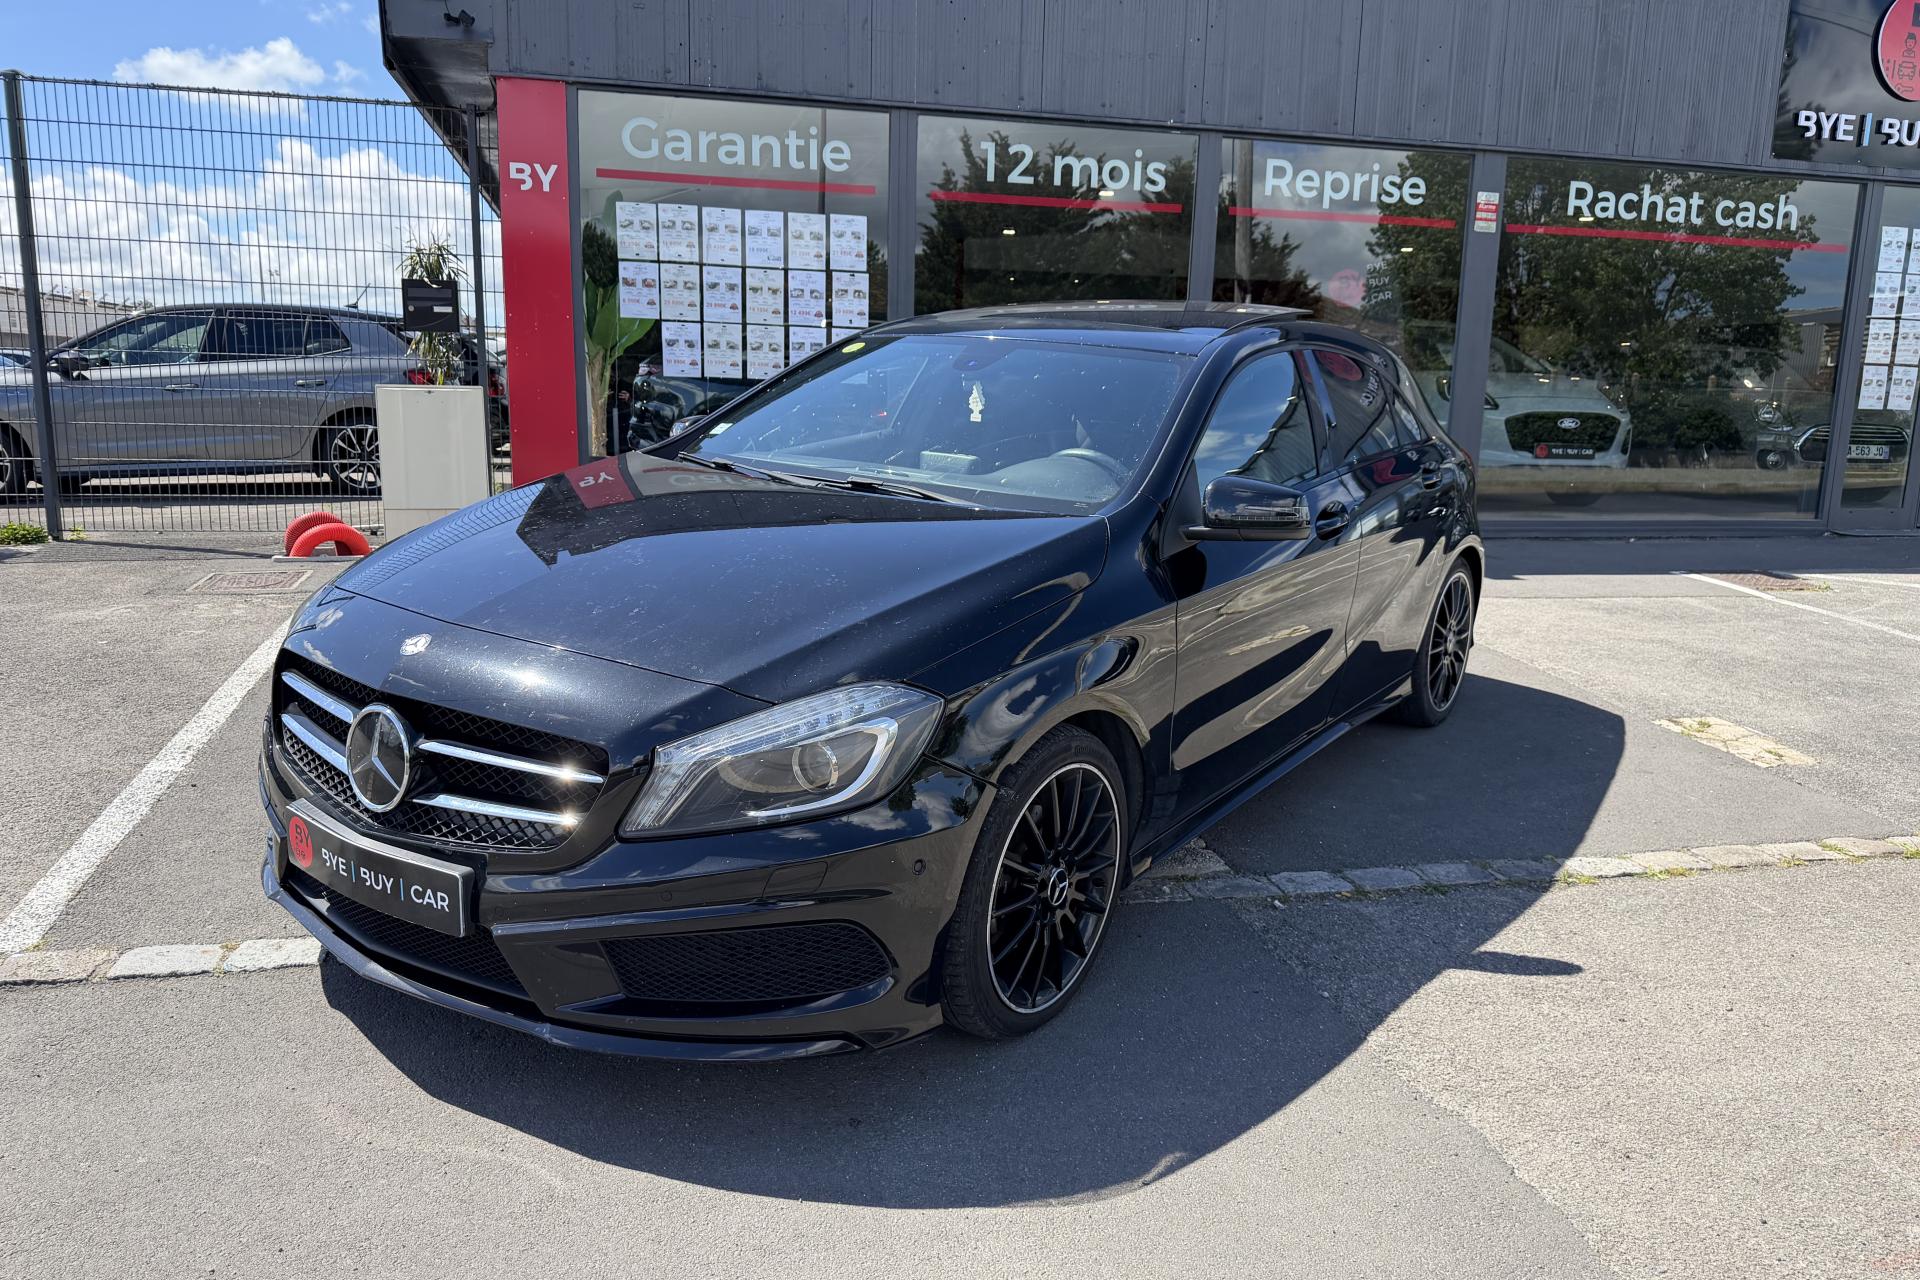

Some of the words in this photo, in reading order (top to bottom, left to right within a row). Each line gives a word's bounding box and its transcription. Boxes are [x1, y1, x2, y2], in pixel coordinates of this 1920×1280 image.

[620, 117, 852, 172] Garantie
[1797, 110, 1857, 141] BYE
[508, 162, 558, 193] BY
[979, 141, 1035, 185] 12
[1053, 148, 1167, 193] mois
[1264, 157, 1427, 211] Reprise
[1566, 179, 1704, 227] Rachat
[1714, 193, 1799, 232] cash
[1368, 275, 1391, 288] BUY
[1371, 290, 1393, 302] CAR
[321, 847, 348, 877] BYE
[360, 866, 394, 895] BUY
[410, 884, 450, 913] CAR
